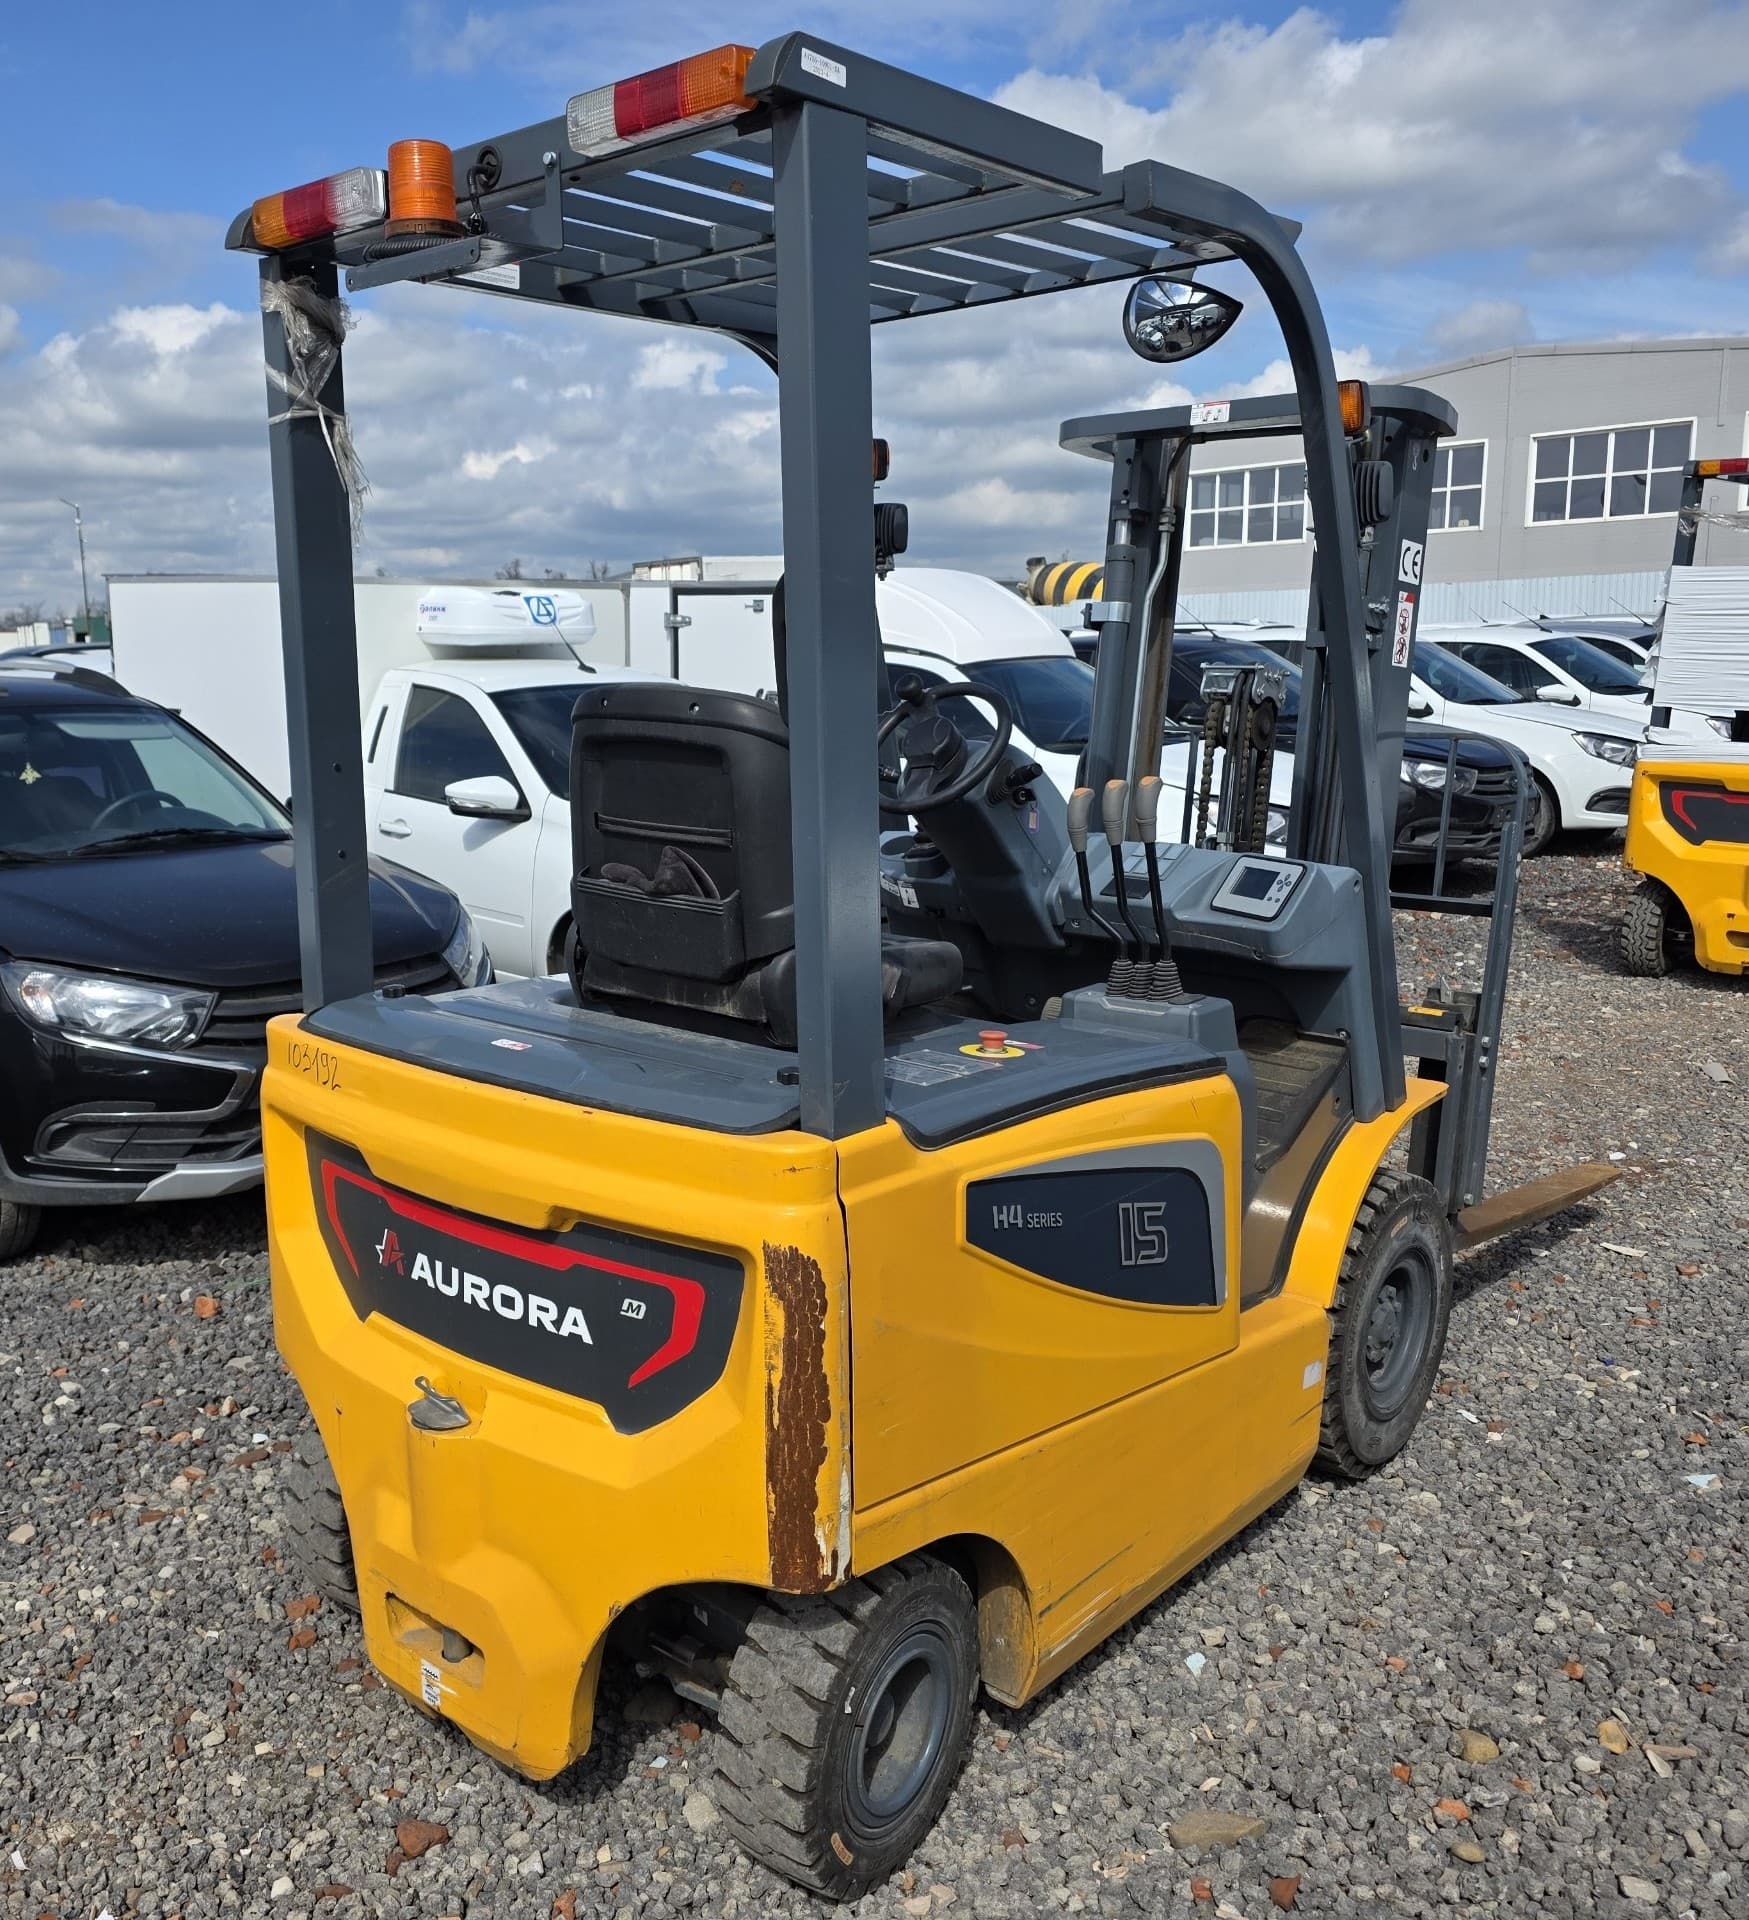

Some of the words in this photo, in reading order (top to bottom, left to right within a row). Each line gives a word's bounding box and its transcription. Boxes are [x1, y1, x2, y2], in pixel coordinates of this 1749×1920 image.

[288, 1041, 342, 1091] 103192
[992, 1204, 1024, 1230] H4
[1026, 1212, 1063, 1228] SERIES
[1118, 1201, 1169, 1266] 15
[410, 1252, 594, 1345] AURORA
